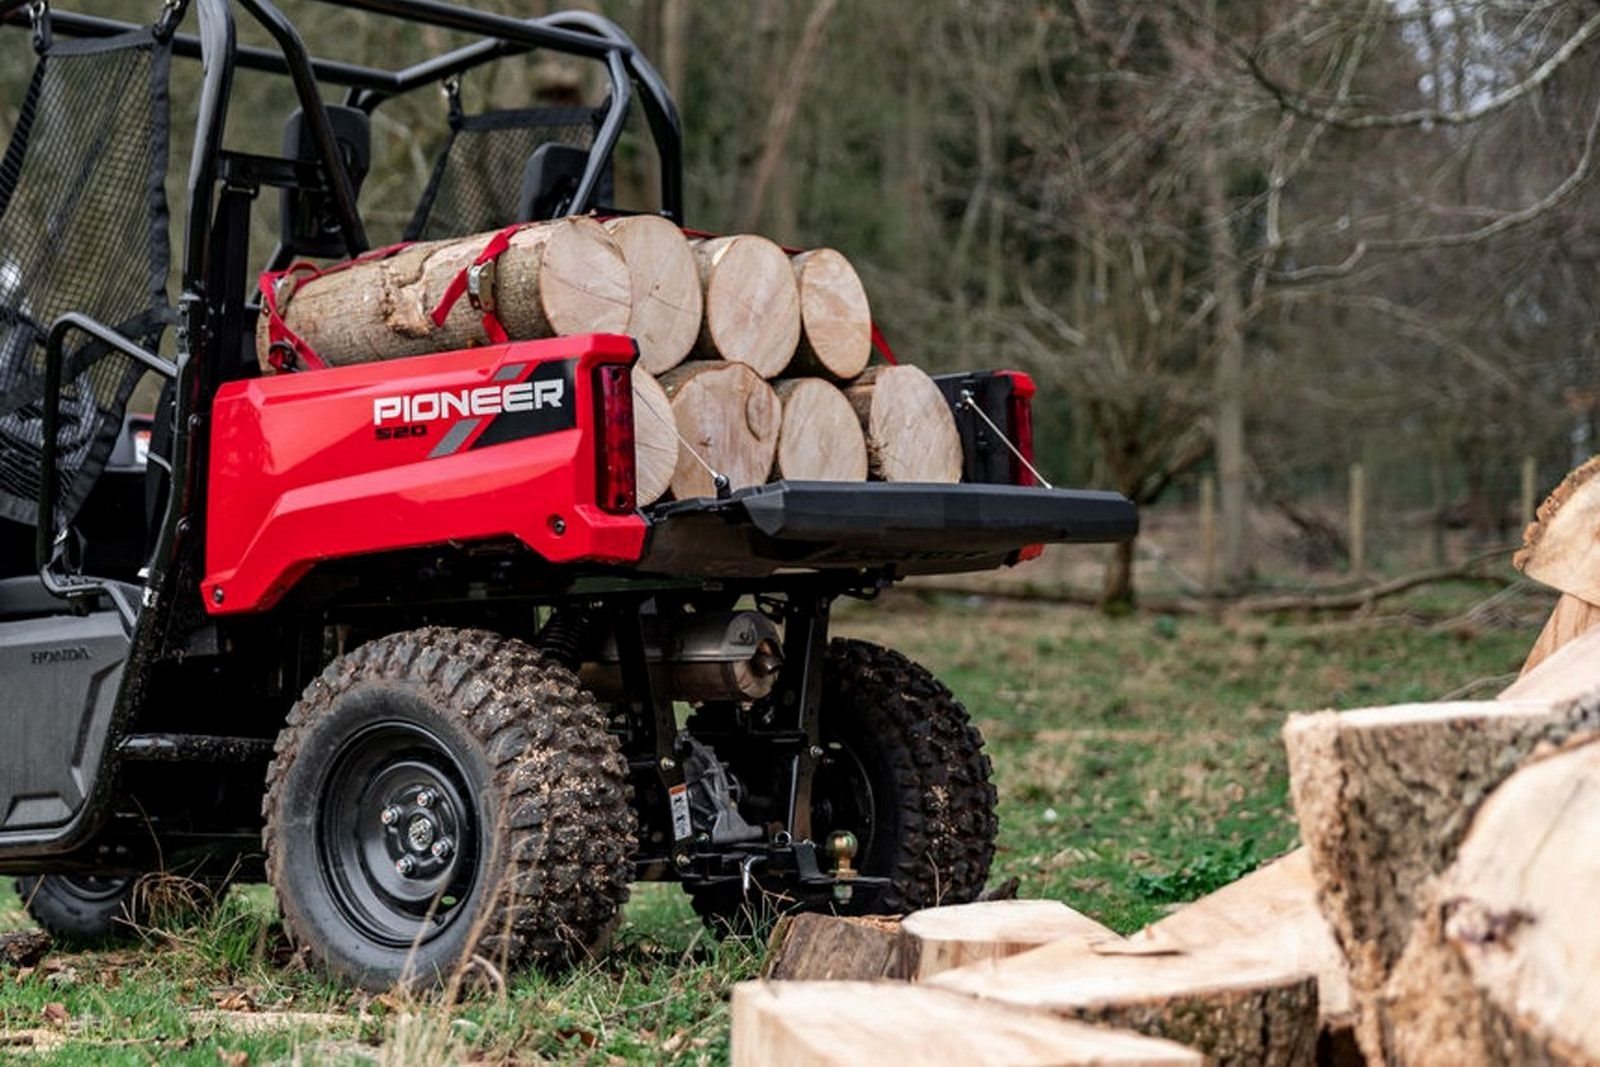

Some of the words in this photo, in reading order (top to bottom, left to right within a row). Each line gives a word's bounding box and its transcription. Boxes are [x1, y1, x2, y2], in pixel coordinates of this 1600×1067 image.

[374, 379, 564, 425] PIONEER
[375, 424, 427, 440] 520
[31, 647, 91, 663] HONDA
